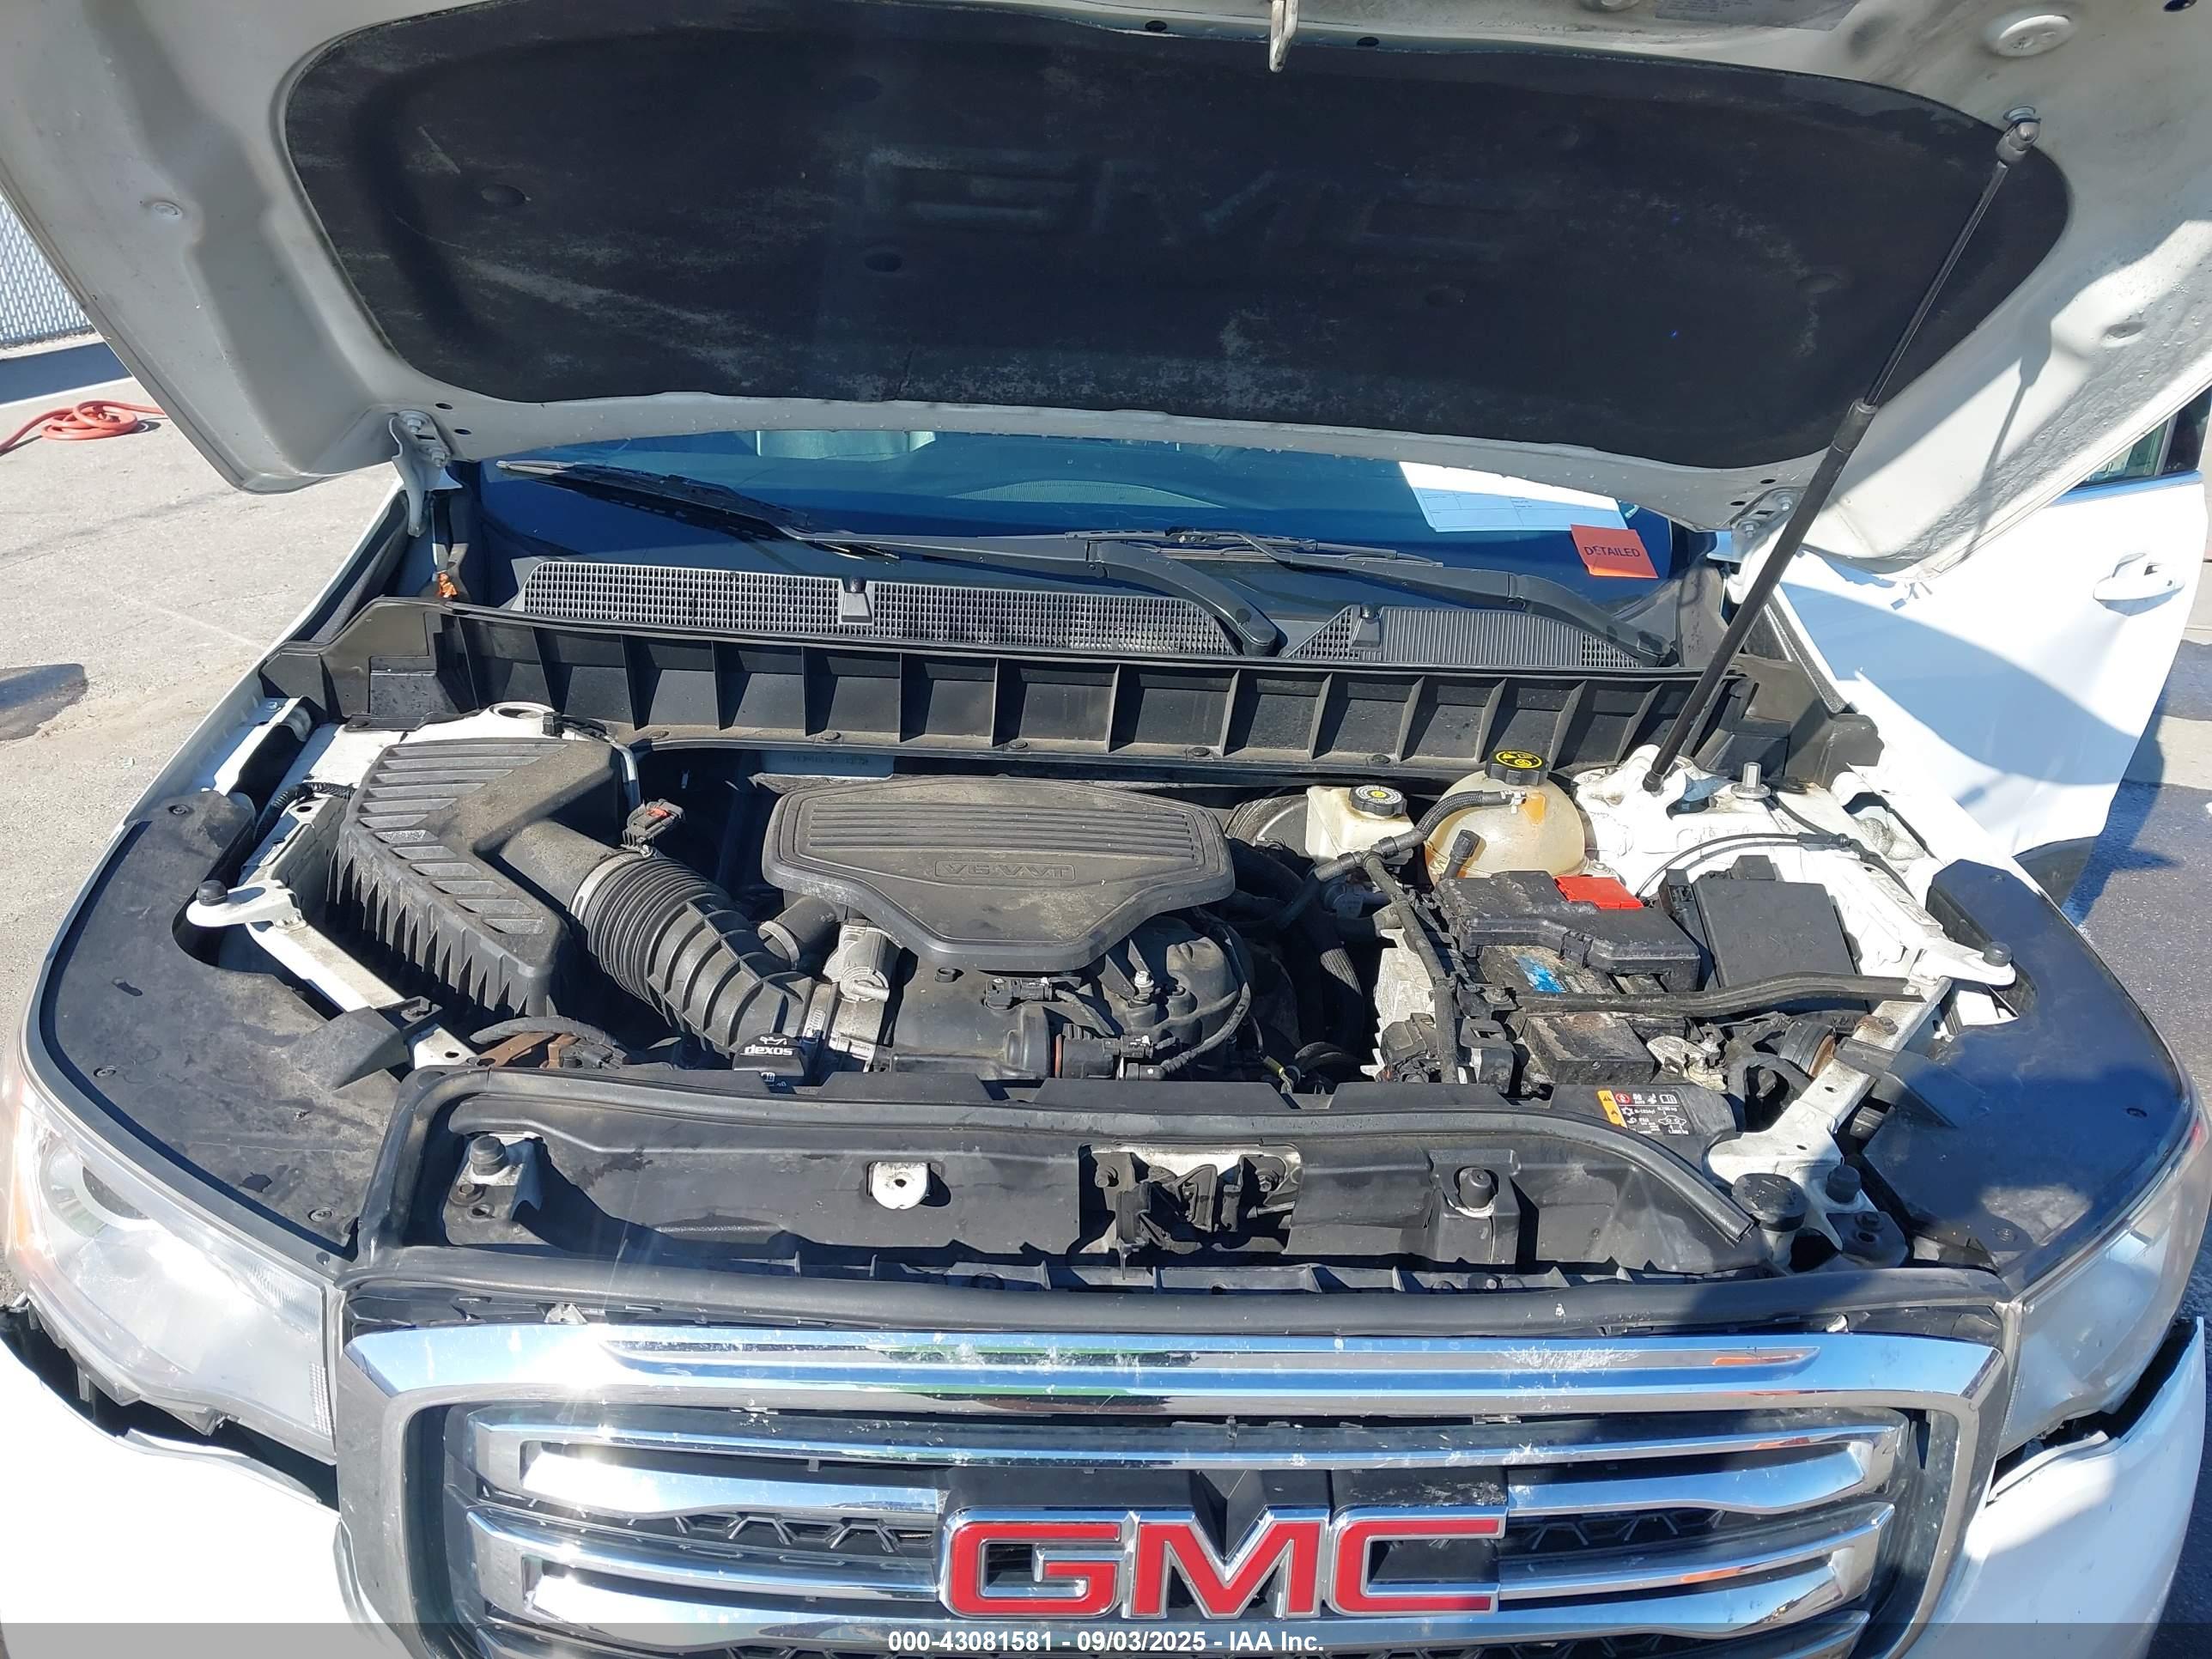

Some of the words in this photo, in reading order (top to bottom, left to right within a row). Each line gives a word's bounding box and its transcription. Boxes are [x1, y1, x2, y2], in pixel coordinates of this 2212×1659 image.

[1583, 545, 1641, 558] DETAILED
[941, 863, 991, 876] V6
[744, 1043, 794, 1056] dexos
[940, 1506, 1509, 1620] GMC
